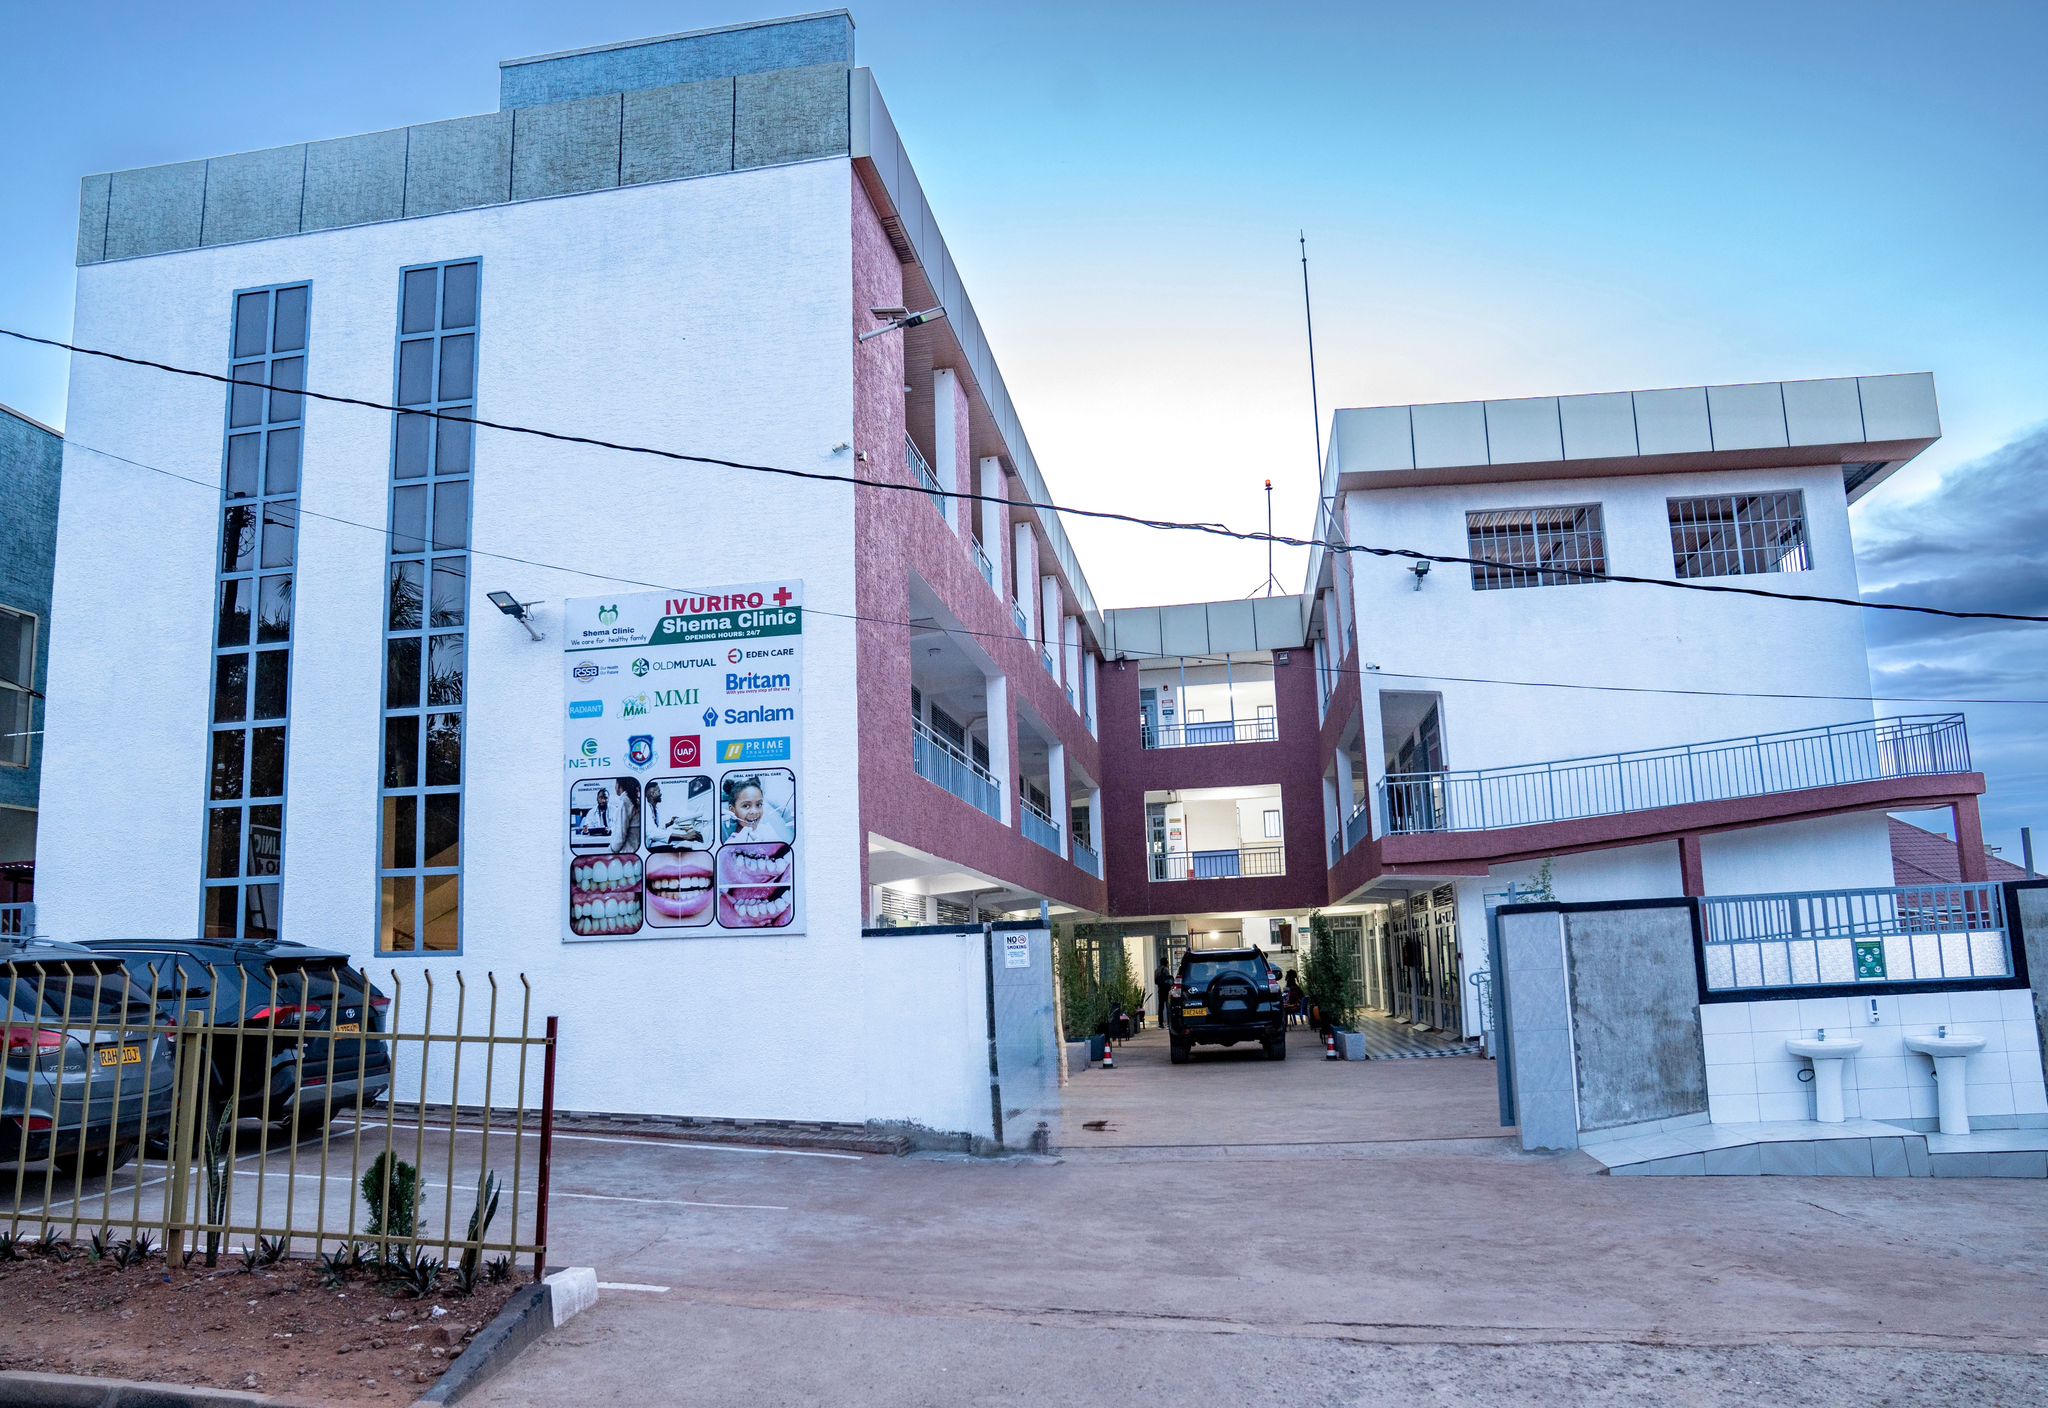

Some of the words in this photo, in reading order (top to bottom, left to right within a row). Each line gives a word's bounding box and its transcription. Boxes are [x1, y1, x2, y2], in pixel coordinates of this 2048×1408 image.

[665, 592, 764, 615] IVURIRO
[662, 617, 732, 634] Shema
[738, 610, 797, 628] Clinic
[685, 632, 716, 640] OPENING
[718, 630, 745, 638] HOURS:
[746, 650, 768, 658] EDEN
[770, 648, 794, 656] CARE
[574, 667, 598, 677] RSSB
[726, 672, 790, 690] Britam
[654, 688, 700, 707] MMI
[569, 706, 602, 714] RADIANT
[724, 706, 794, 724] Sanlam
[746, 740, 784, 750] PRIME
[677, 748, 694, 756] UAP
[569, 757, 611, 768] NETIS
